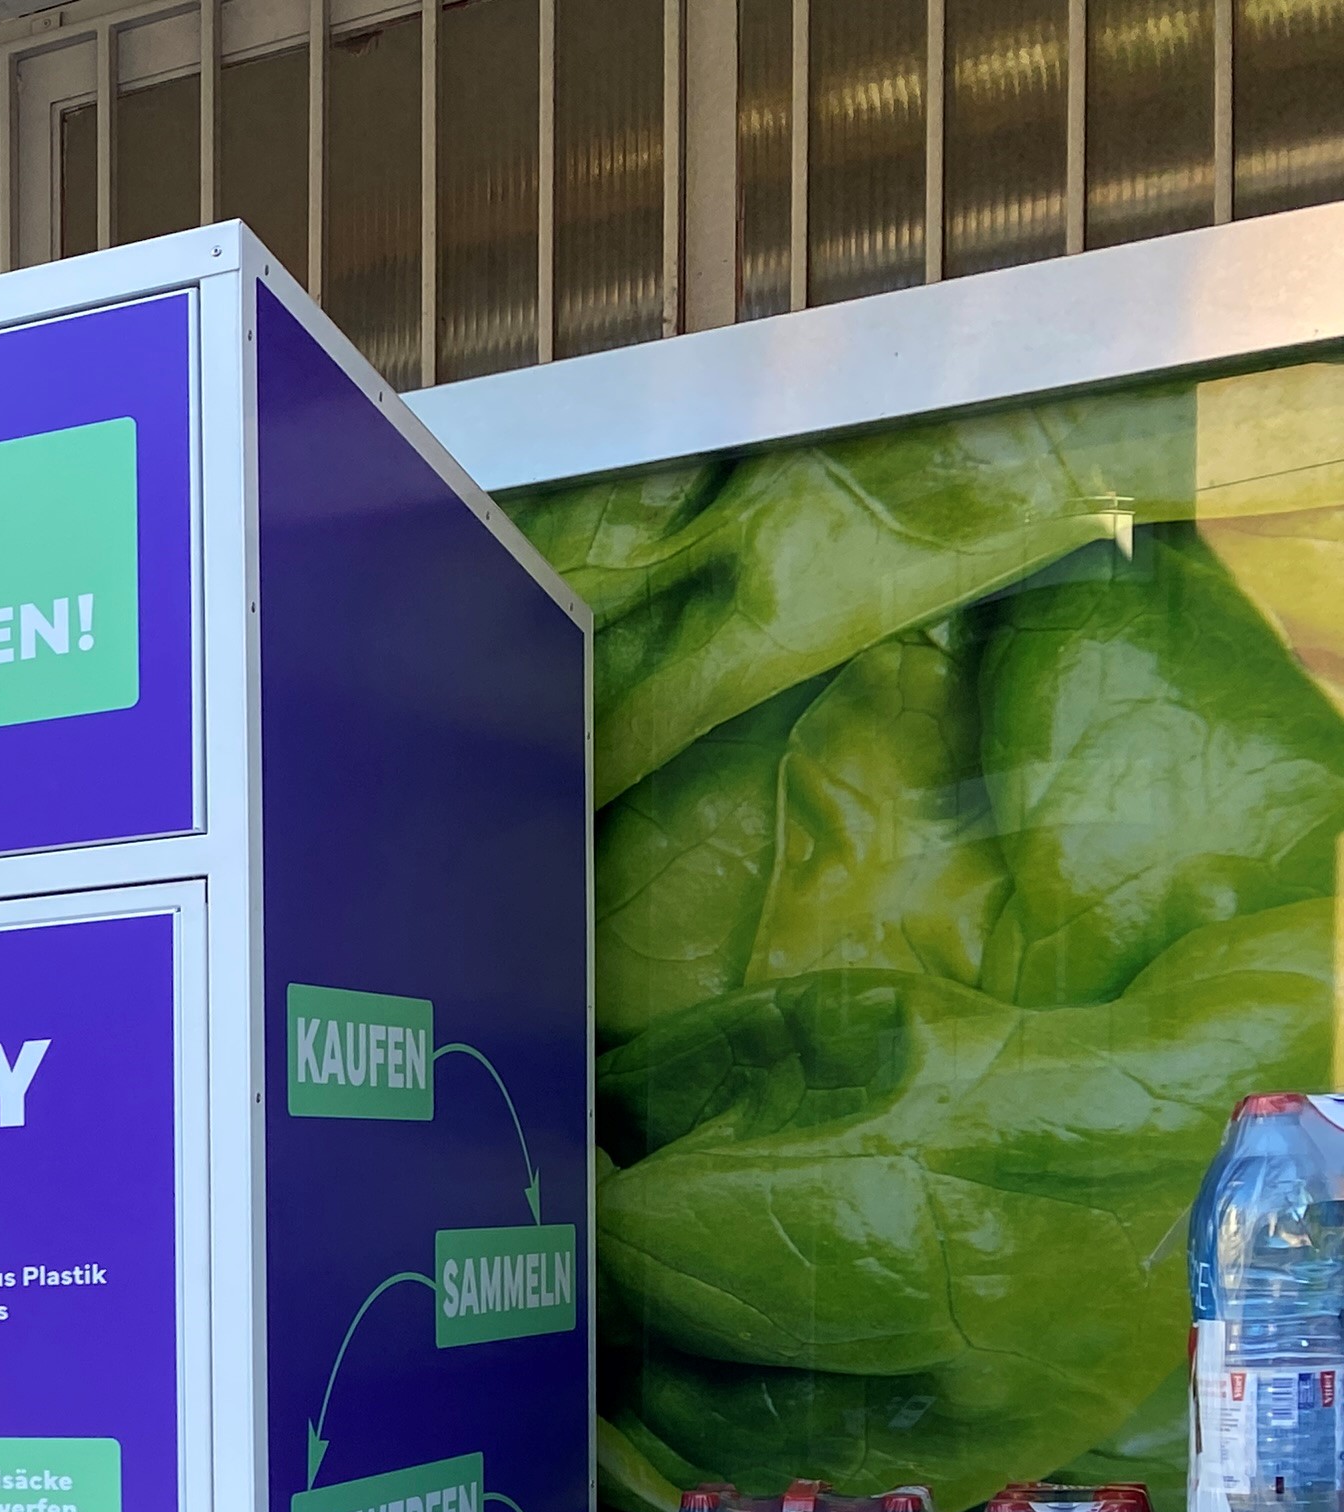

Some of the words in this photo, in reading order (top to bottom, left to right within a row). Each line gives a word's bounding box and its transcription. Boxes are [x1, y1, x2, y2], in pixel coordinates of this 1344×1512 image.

[297, 1017, 426, 1090] KAUFEN
[23, 1264, 107, 1288] Plastik
[443, 1251, 571, 1319] SAMMELN
